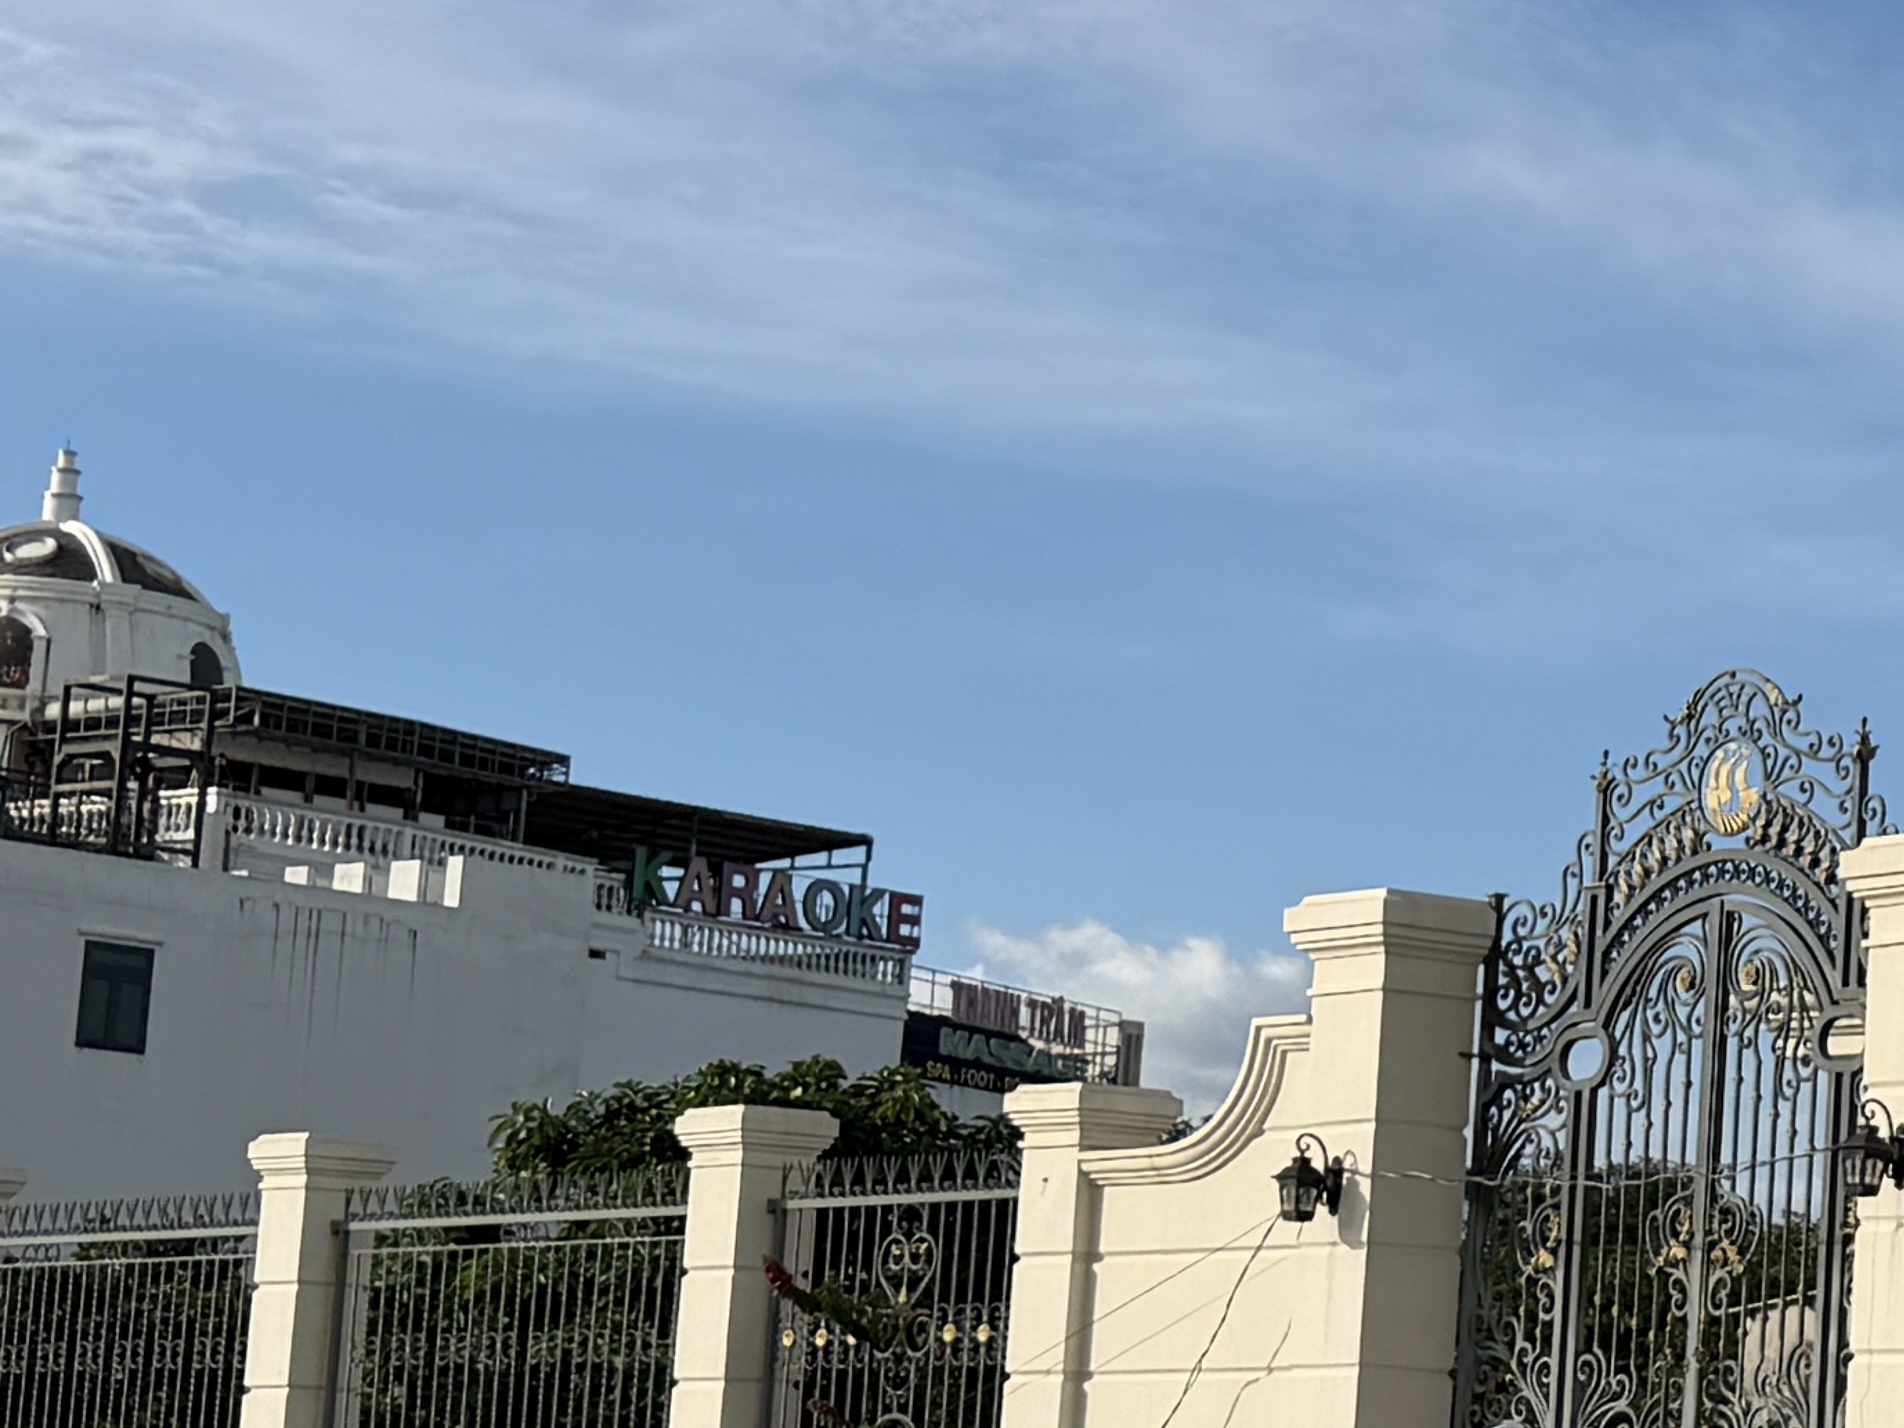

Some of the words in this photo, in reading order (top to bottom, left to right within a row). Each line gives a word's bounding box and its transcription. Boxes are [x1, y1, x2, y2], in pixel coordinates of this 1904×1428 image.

[632, 845, 925, 949] KARAOKE
[938, 1027, 1090, 1080] MASSAGE
[960, 1067, 995, 1090] FOOT
